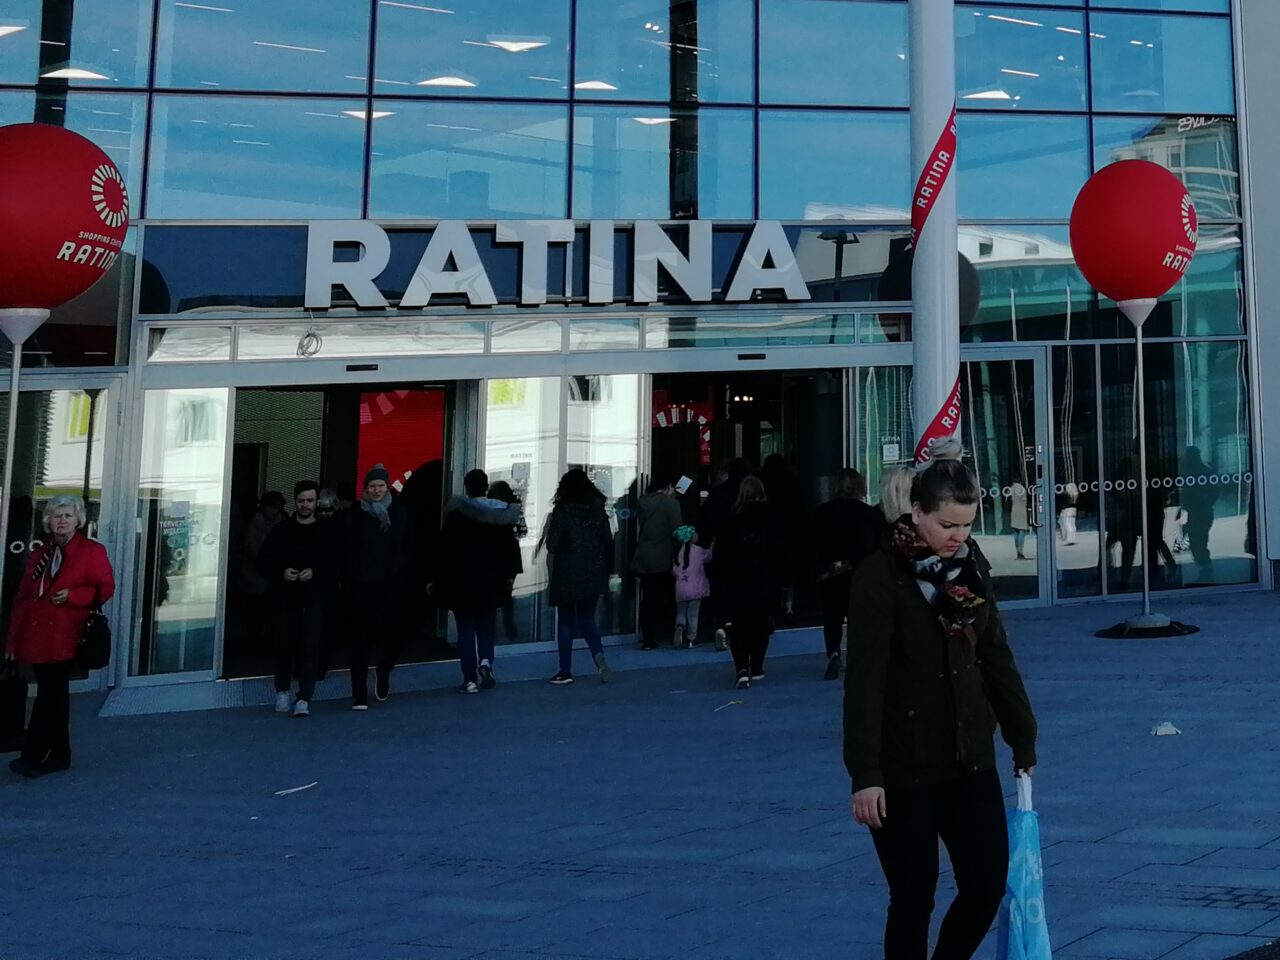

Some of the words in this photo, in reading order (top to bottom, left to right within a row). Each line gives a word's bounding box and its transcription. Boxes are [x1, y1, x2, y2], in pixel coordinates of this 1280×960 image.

[916, 150, 950, 208] RATINA
[56, 240, 119, 271] RATIN
[304, 219, 812, 308] RATINA
